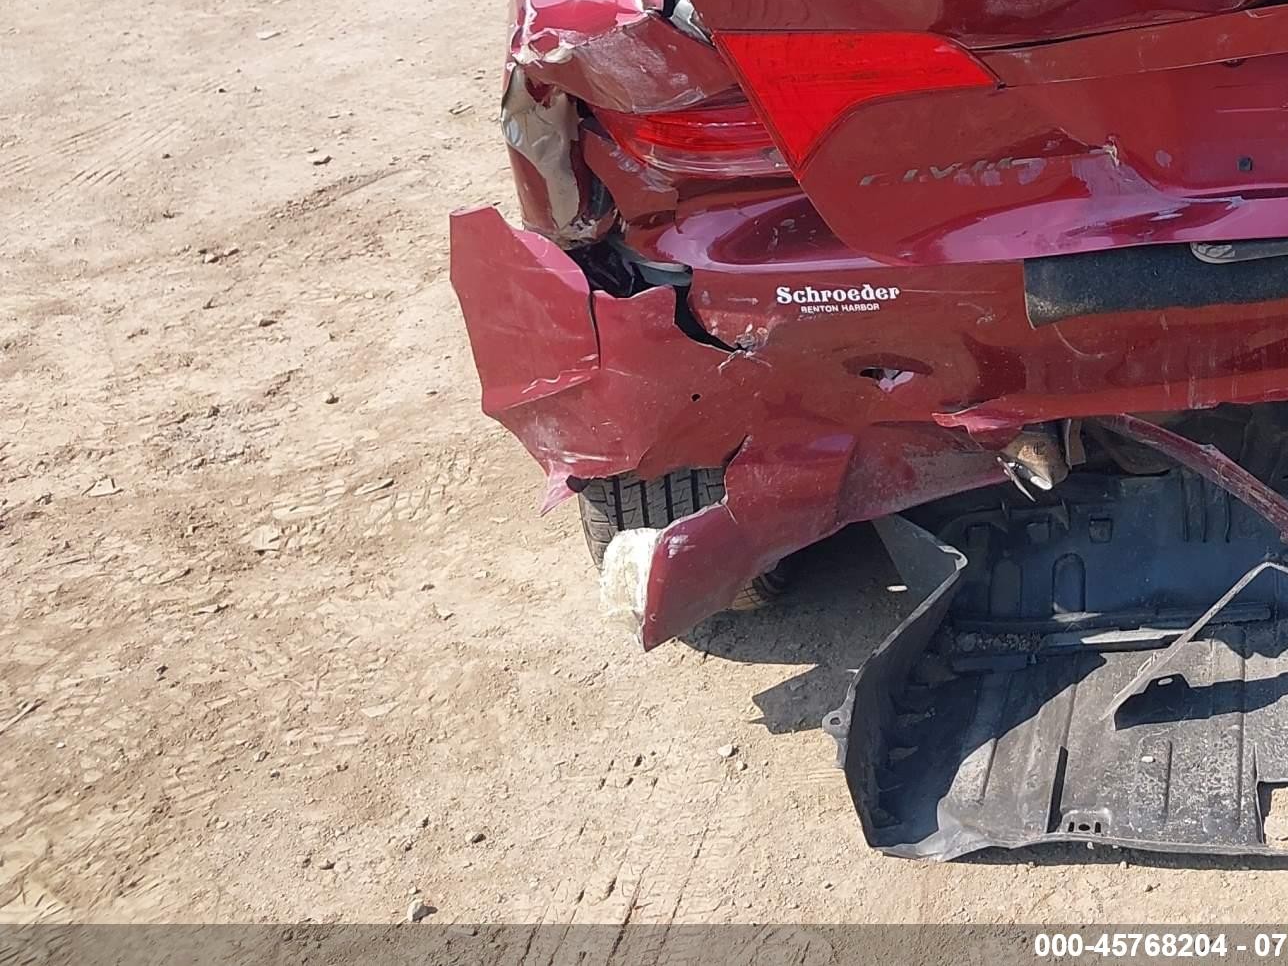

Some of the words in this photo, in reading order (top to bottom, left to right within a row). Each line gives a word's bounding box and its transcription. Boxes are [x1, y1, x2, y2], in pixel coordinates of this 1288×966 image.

[776, 283, 900, 304] Schroeder
[801, 305, 839, 314] BENTON
[841, 302, 880, 312] HARBOR
